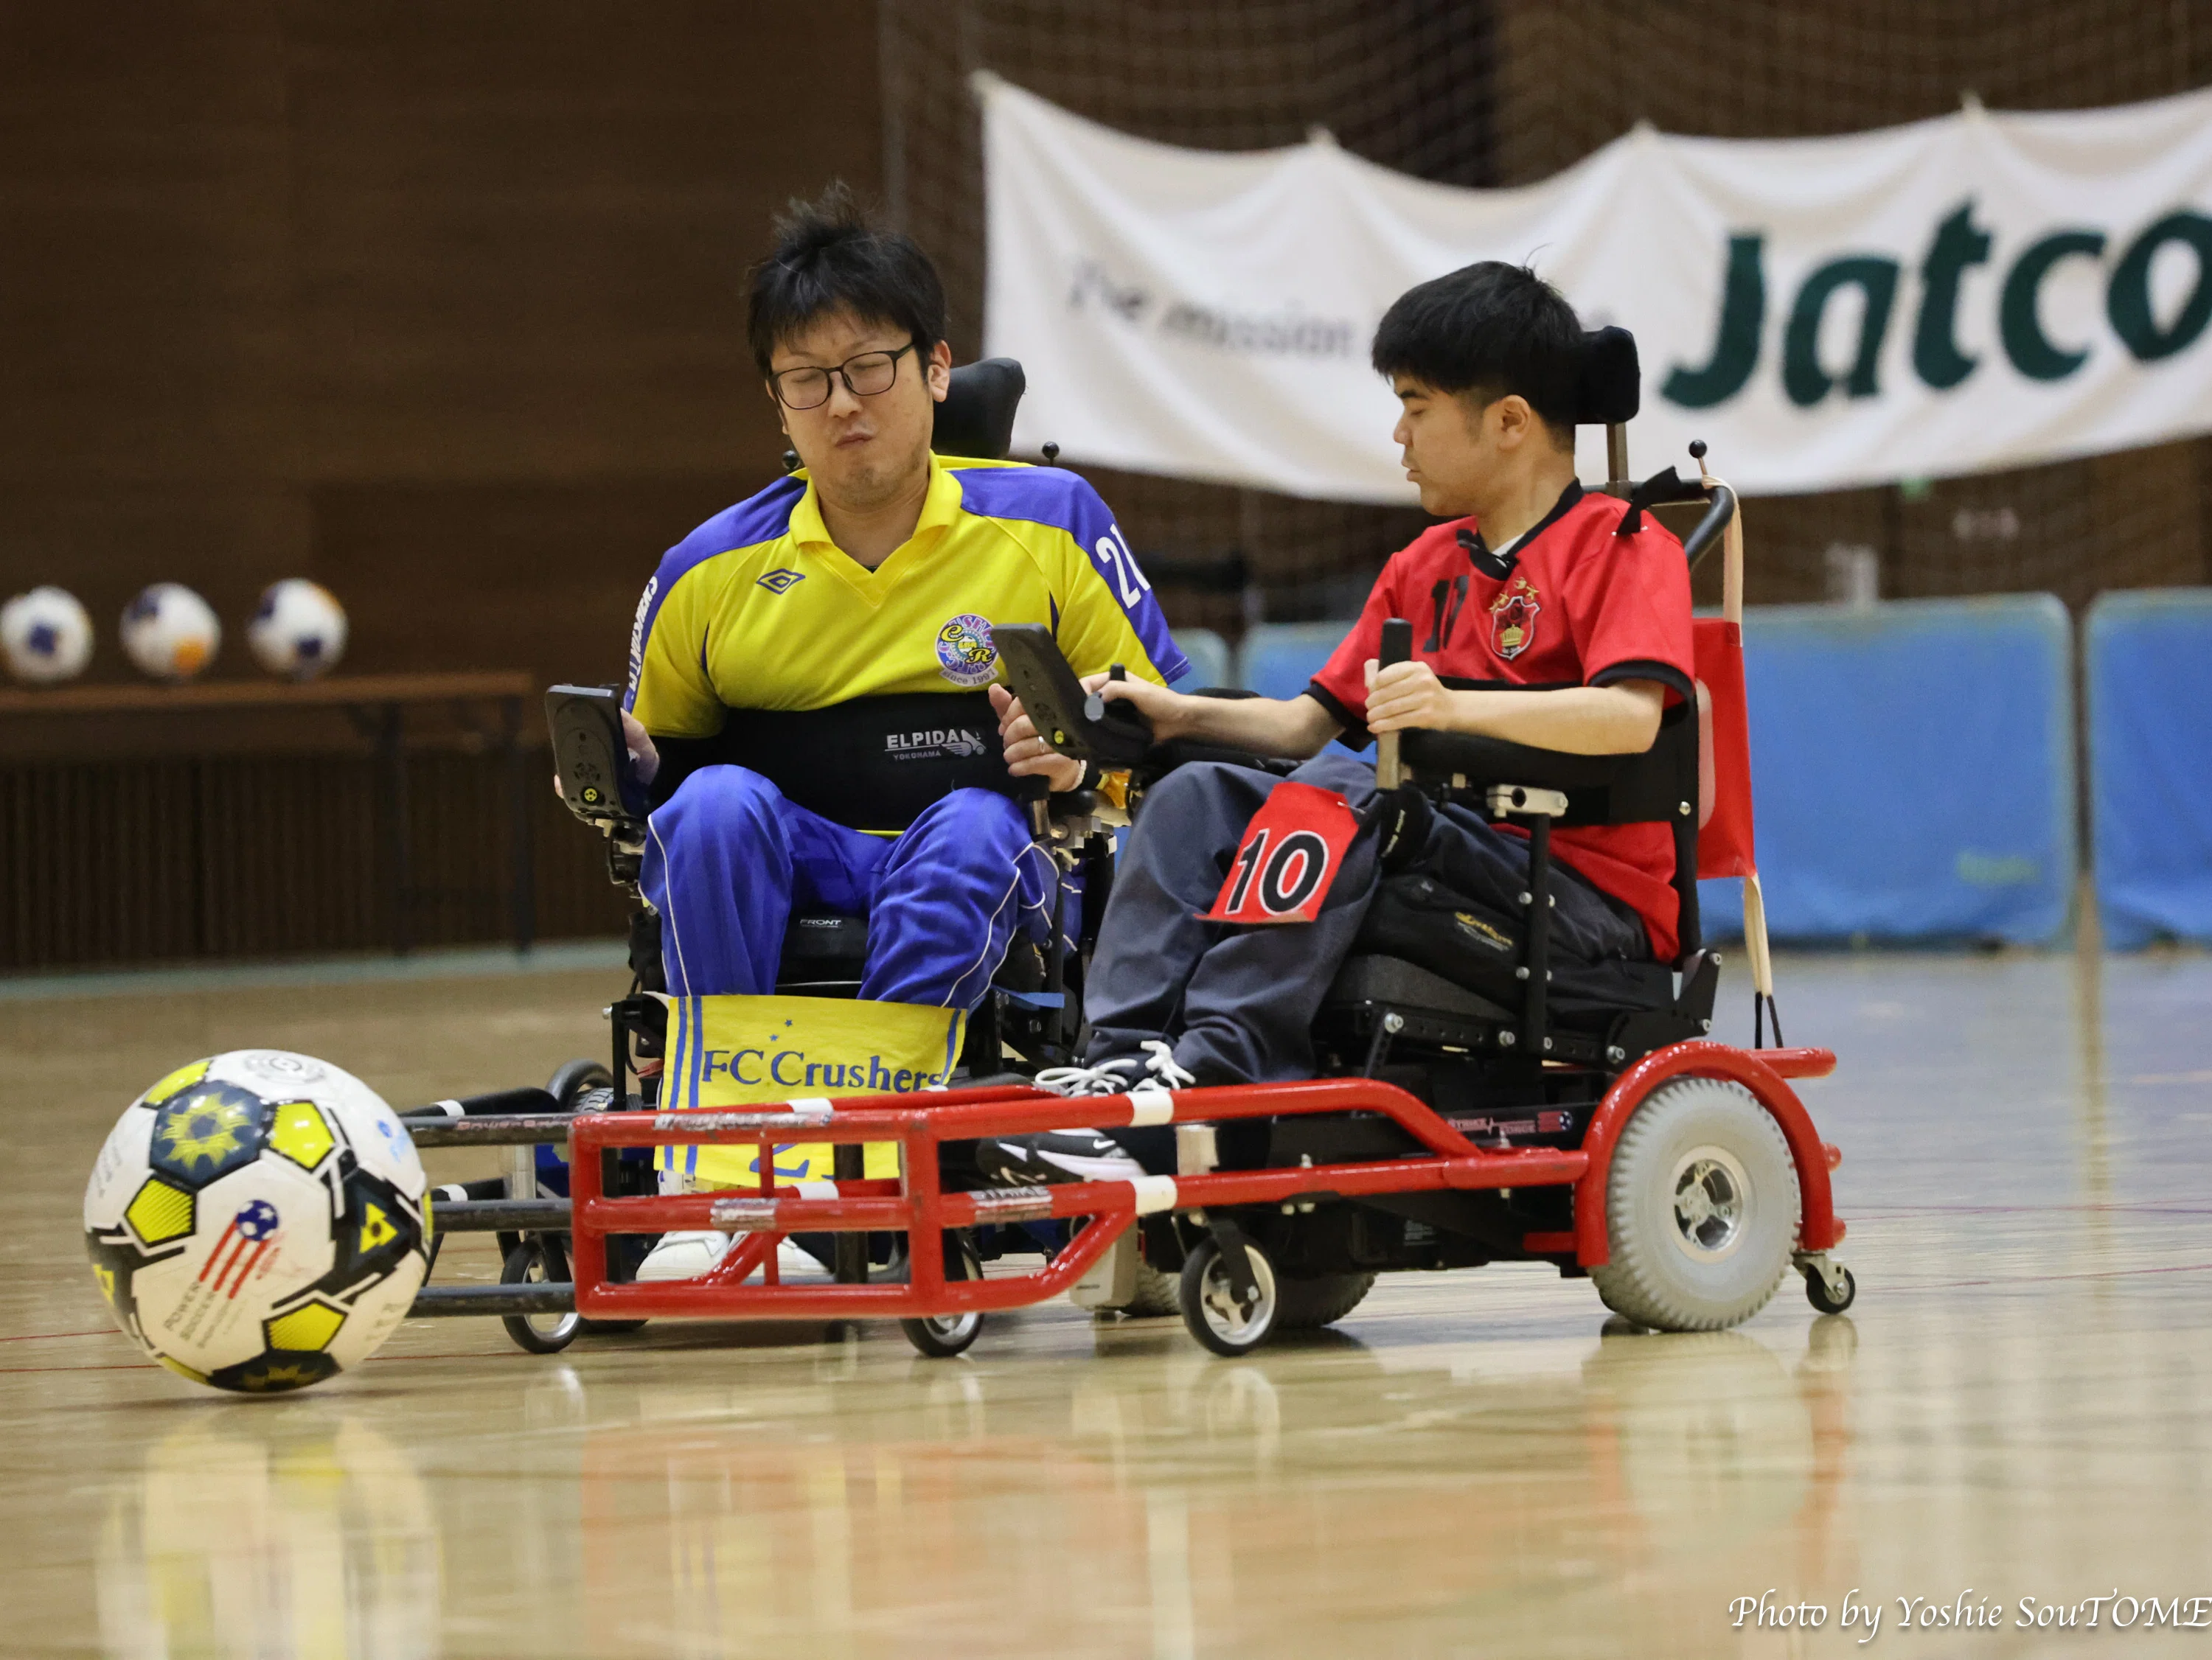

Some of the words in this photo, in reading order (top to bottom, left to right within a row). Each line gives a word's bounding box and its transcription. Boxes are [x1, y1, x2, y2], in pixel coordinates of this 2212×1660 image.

[1659, 196, 2212, 409] Jatco
[973, 668, 995, 685] 1997
[886, 729, 960, 749] ELPIDA
[893, 750, 942, 761] YOKOHAMA
[1224, 827, 1329, 916] 10
[702, 1050, 764, 1086] FC
[771, 1050, 944, 1093] Crushers
